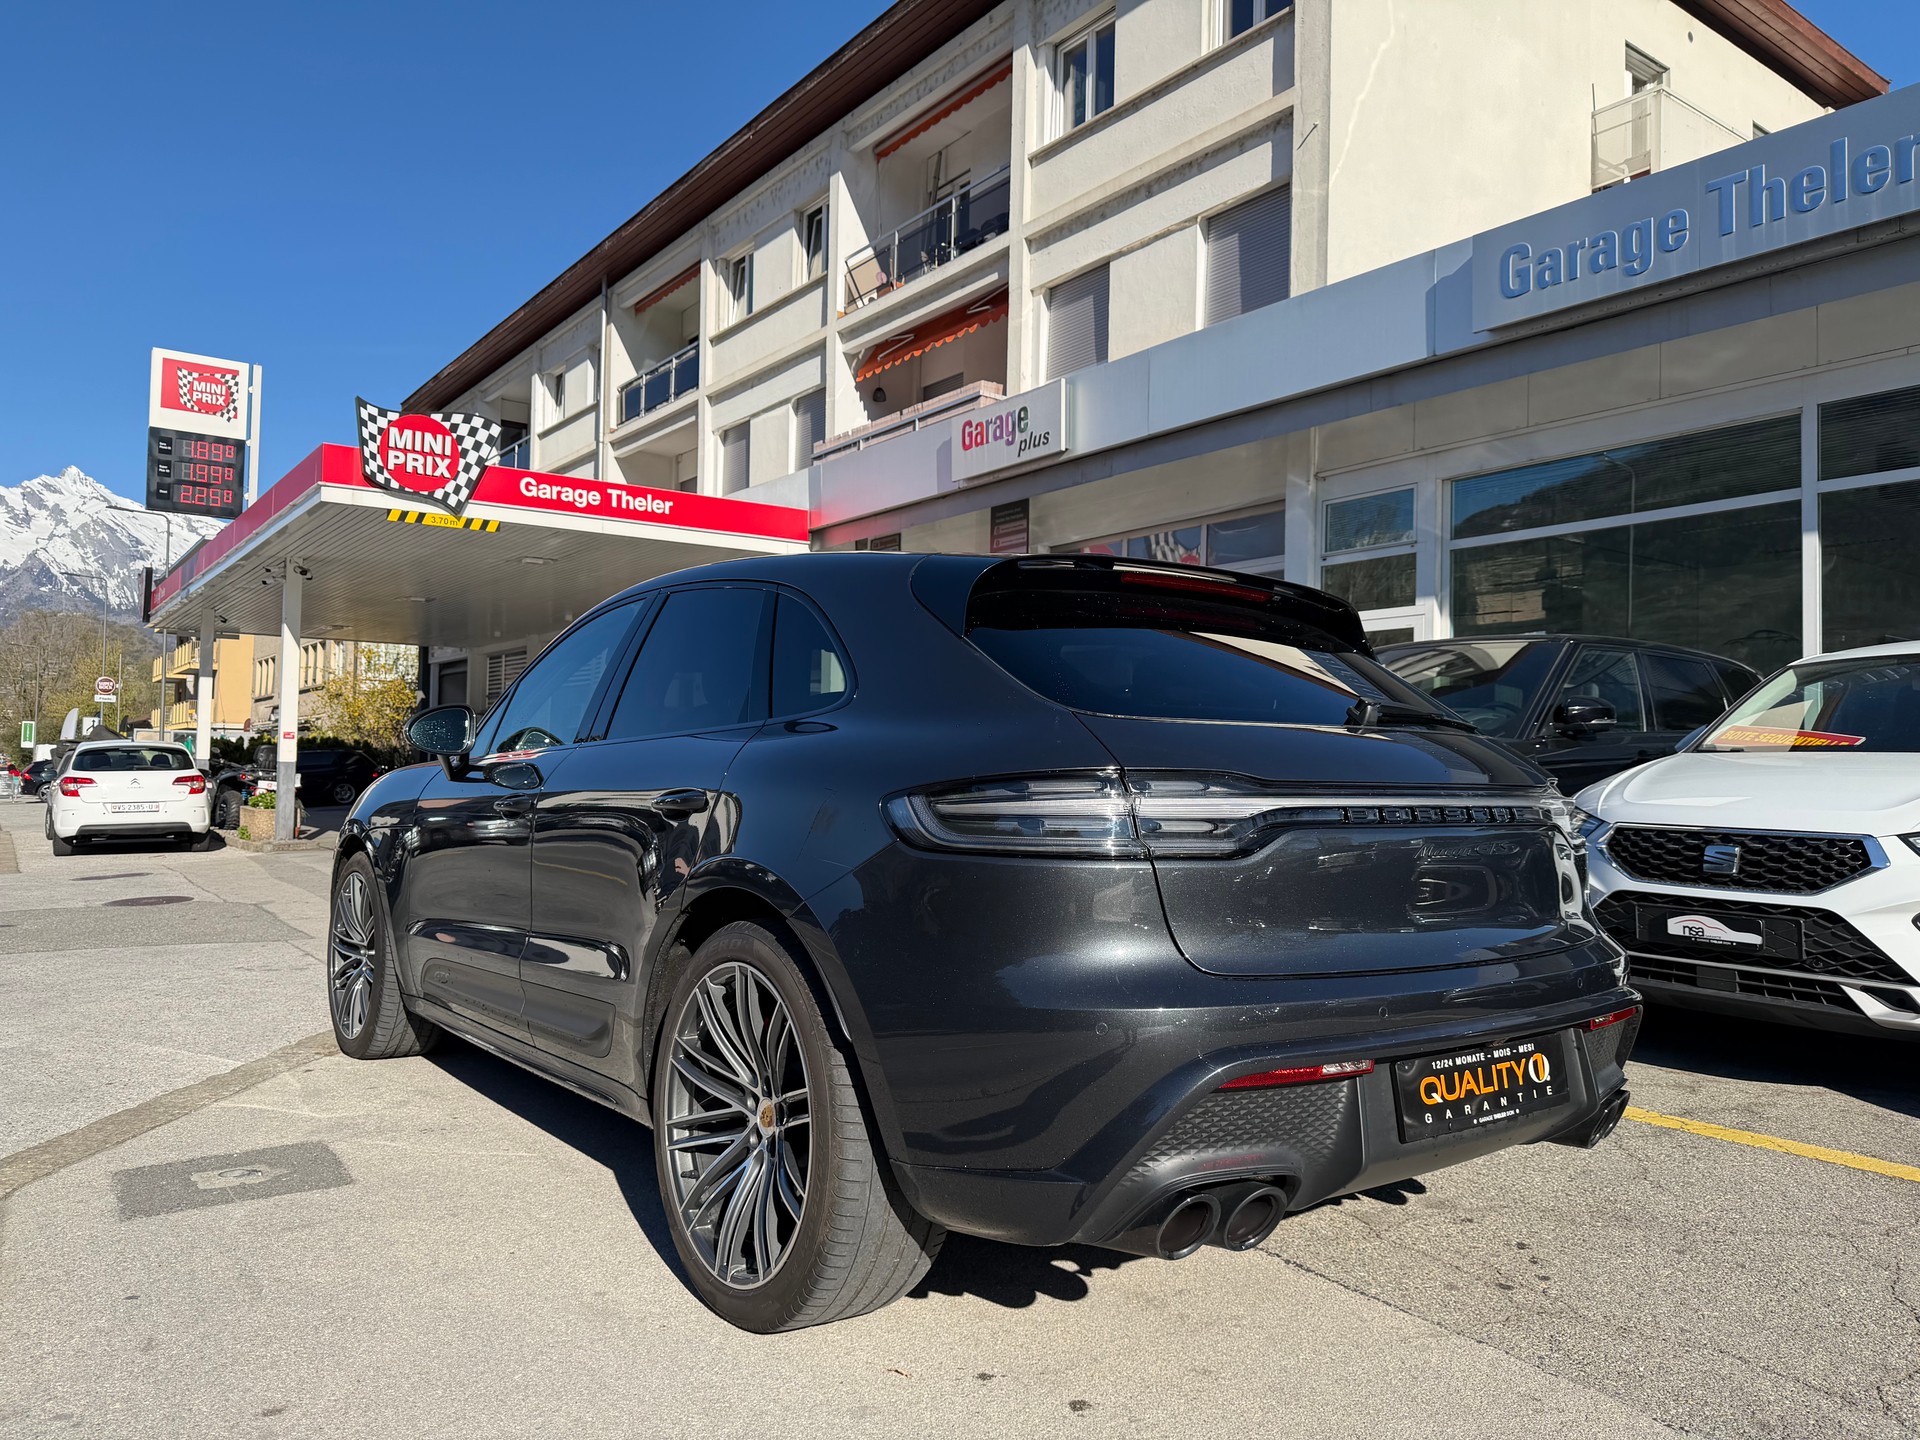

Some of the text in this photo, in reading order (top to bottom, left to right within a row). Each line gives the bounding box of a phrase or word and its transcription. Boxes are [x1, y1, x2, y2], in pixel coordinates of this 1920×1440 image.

[1500, 131, 1920, 298] Garage Theler
[192, 380, 226, 395] MINI
[192, 391, 226, 406] PRIX
[388, 426, 452, 457] MINI
[961, 405, 1029, 452] Garage
[1017, 430, 1050, 458] plus
[387, 450, 452, 479] PRIX
[519, 477, 674, 515] Garage Theler
[431, 515, 458, 526] 3.70 m
[1720, 730, 1754, 741] BOITE
[1682, 925, 1704, 937] nsa
[1431, 1058, 1453, 1069] 12/24
[1455, 1053, 1486, 1065] MONATE
[1493, 1047, 1511, 1059] MOIS
[1518, 1043, 1535, 1054] MESI
[1420, 1058, 1527, 1105] QUALITY
[1425, 1085, 1553, 1124] GARANTIE
